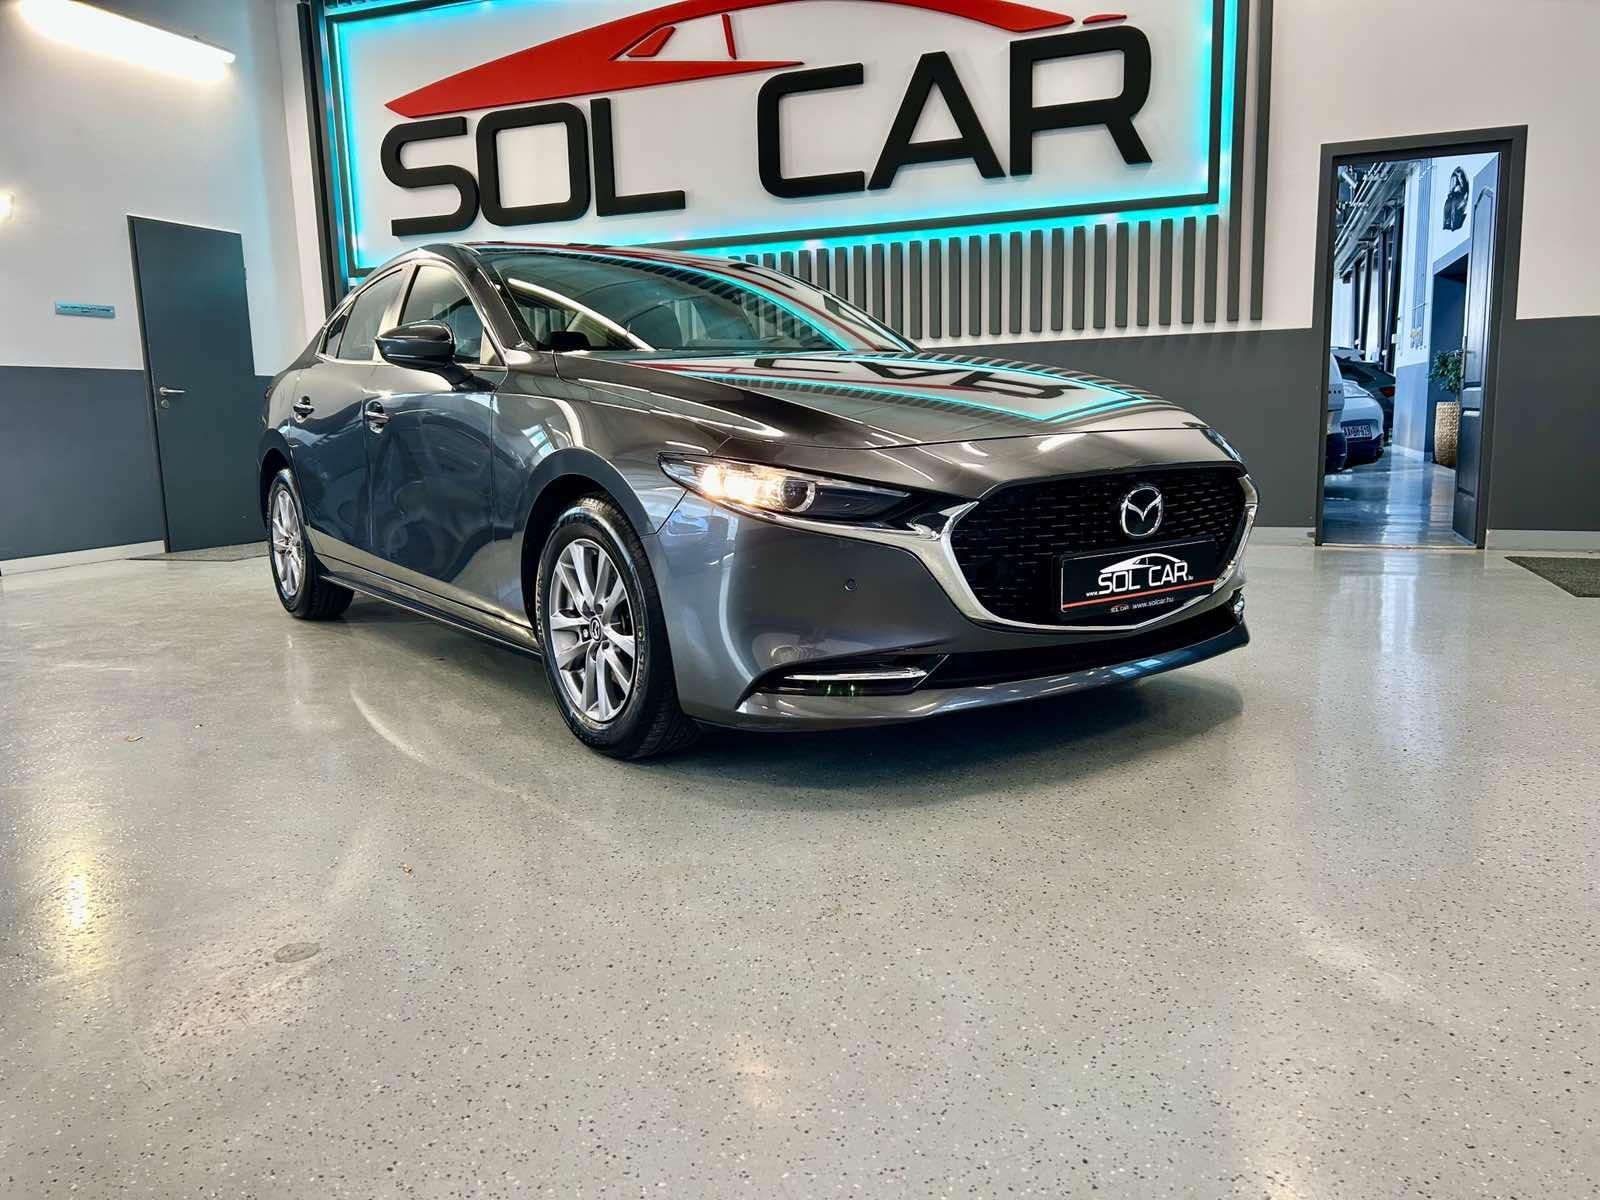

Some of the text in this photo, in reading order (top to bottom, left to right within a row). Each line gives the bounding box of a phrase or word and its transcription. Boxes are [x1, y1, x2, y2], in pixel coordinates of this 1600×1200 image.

[381, 25, 1152, 236] SOL CAR
[1132, 597, 1174, 609] www.solcar.hu
